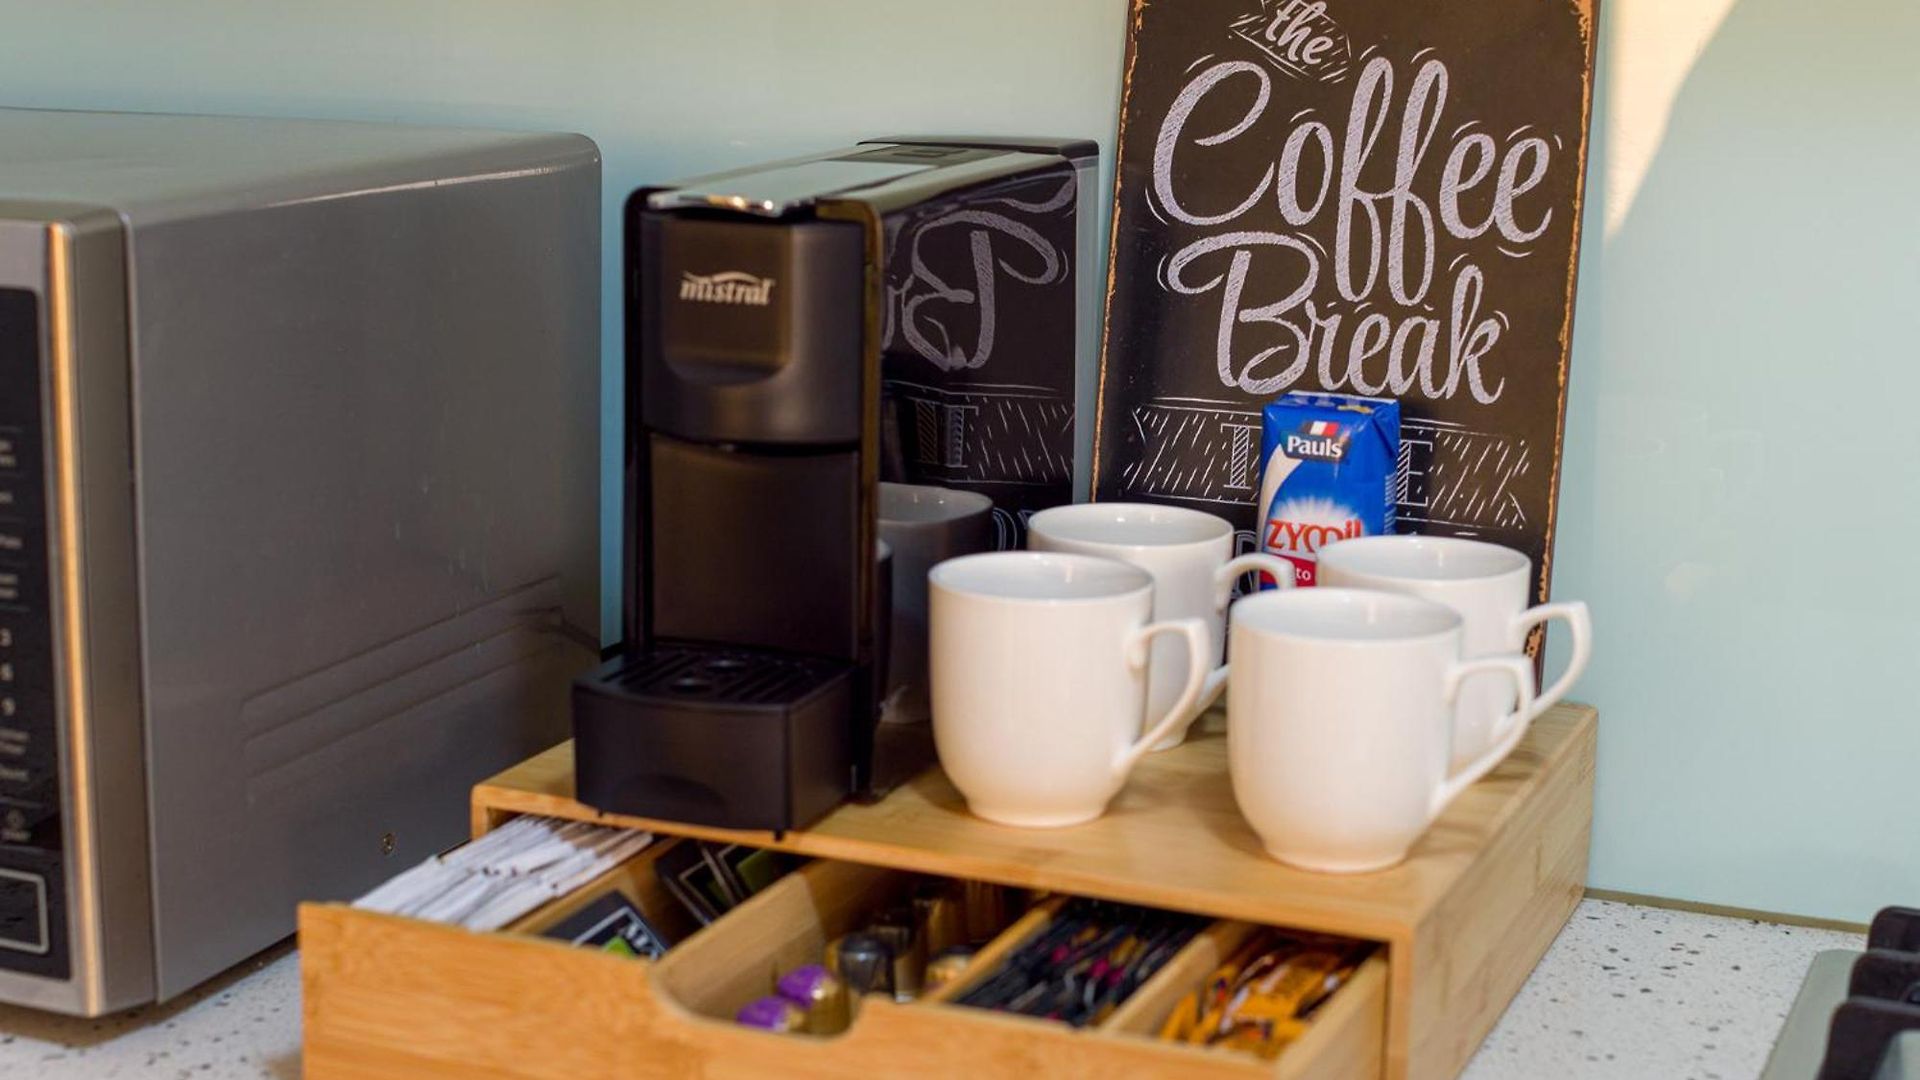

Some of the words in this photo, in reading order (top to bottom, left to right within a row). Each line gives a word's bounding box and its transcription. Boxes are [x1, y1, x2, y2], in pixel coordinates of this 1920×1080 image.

[1265, 0, 1334, 65] the
[1153, 57, 1553, 306] Coffee
[680, 272, 774, 306] mistral
[1167, 231, 1505, 405] Break
[1287, 434, 1343, 458] Pauls
